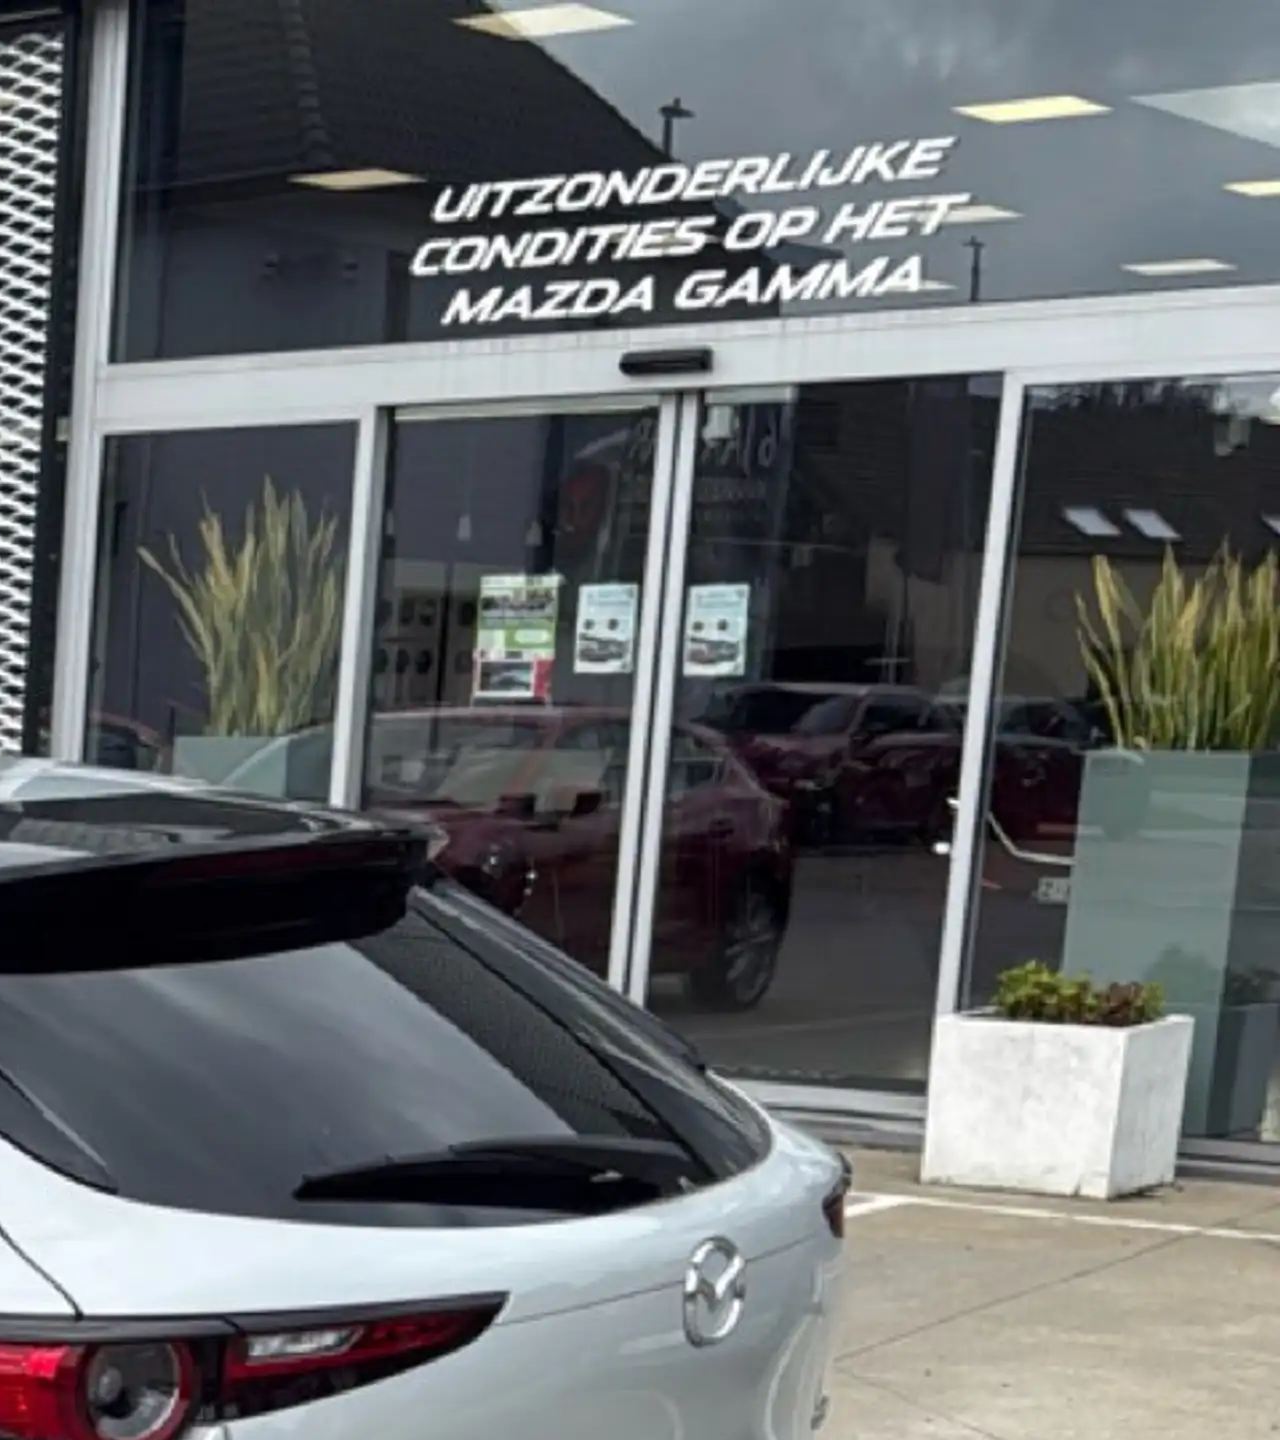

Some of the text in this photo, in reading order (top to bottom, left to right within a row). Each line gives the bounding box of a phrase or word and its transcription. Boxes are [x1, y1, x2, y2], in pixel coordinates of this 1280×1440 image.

[430, 135, 958, 223] UITZONDERLIJKE
[410, 193, 971, 276] CONDITIES OP HET
[440, 254, 924, 325] MAZDA GAMMA
